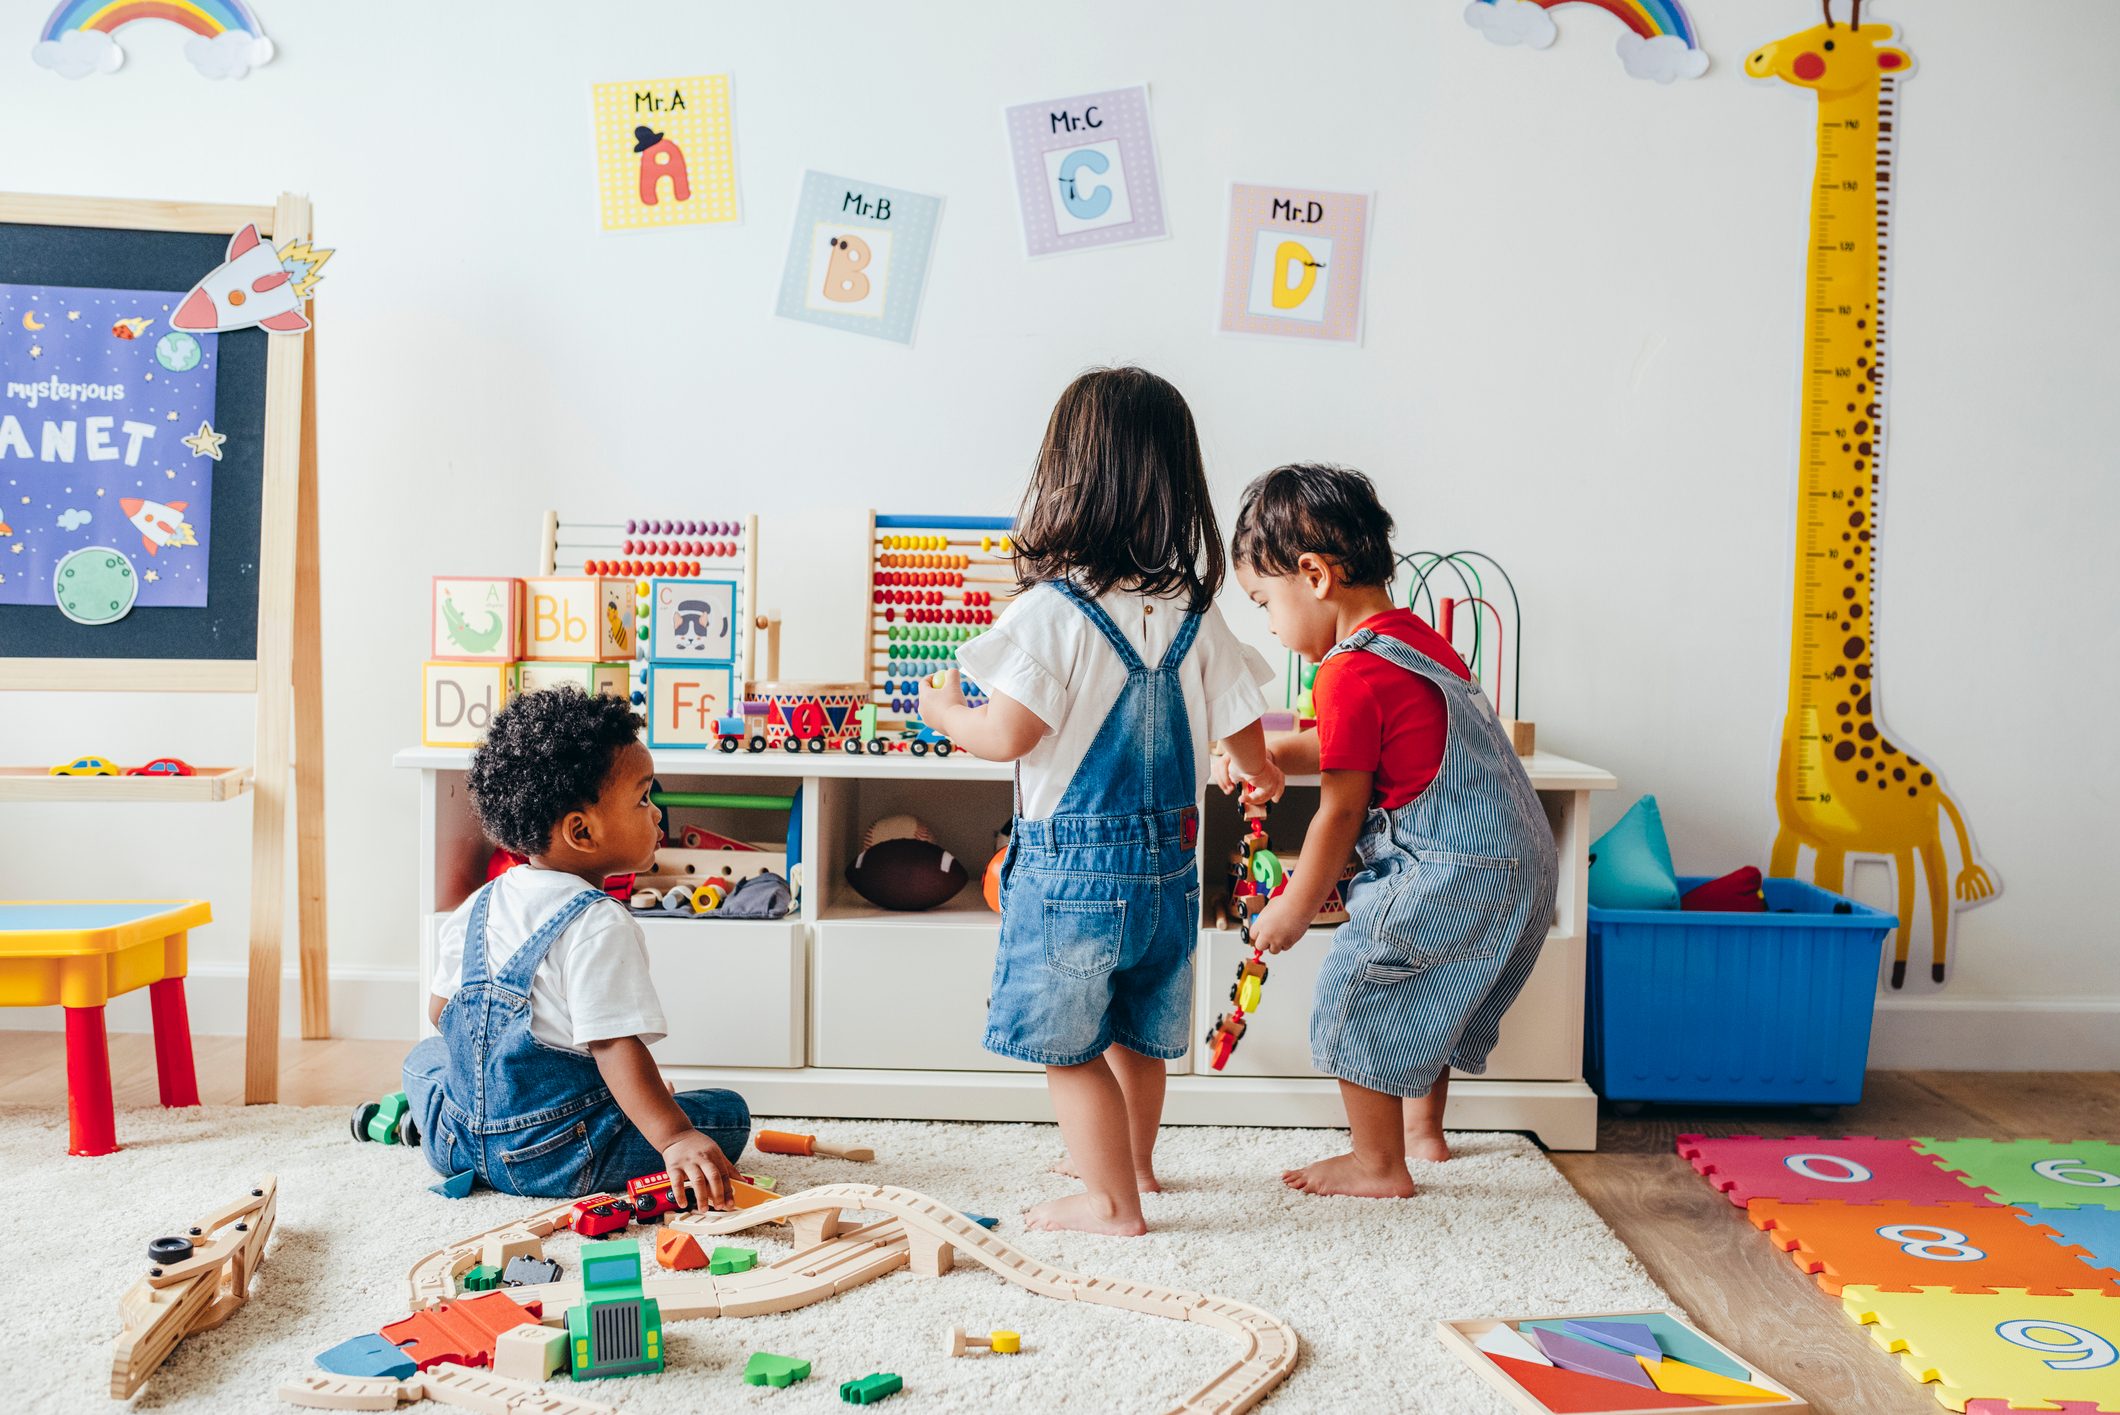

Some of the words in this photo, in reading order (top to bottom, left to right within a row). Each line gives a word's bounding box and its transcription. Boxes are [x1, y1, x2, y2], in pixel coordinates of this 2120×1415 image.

[634, 89, 686, 113] Mr.A
[1050, 106, 1103, 134] Mr.C
[639, 138, 692, 206] A
[1058, 148, 1113, 221] C
[842, 191, 892, 221] Mr.B
[1272, 198, 1324, 224] Mr.D
[822, 234, 873, 304] B
[1271, 240, 1318, 310] D
[7, 374, 125, 408] mysterious
[0, 415, 157, 467] ANET
[486, 583, 500, 602] A
[660, 587, 673, 605] C
[533, 594, 588, 643] Bb
[522, 670, 532, 689] E
[435, 679, 492, 729] Dd
[672, 682, 716, 730] Ff
[1783, 1153, 1873, 1184] 0
[2031, 1158, 2120, 1188] 6
[1875, 1224, 1988, 1262] 8
[1995, 1319, 2120, 1371] 9
